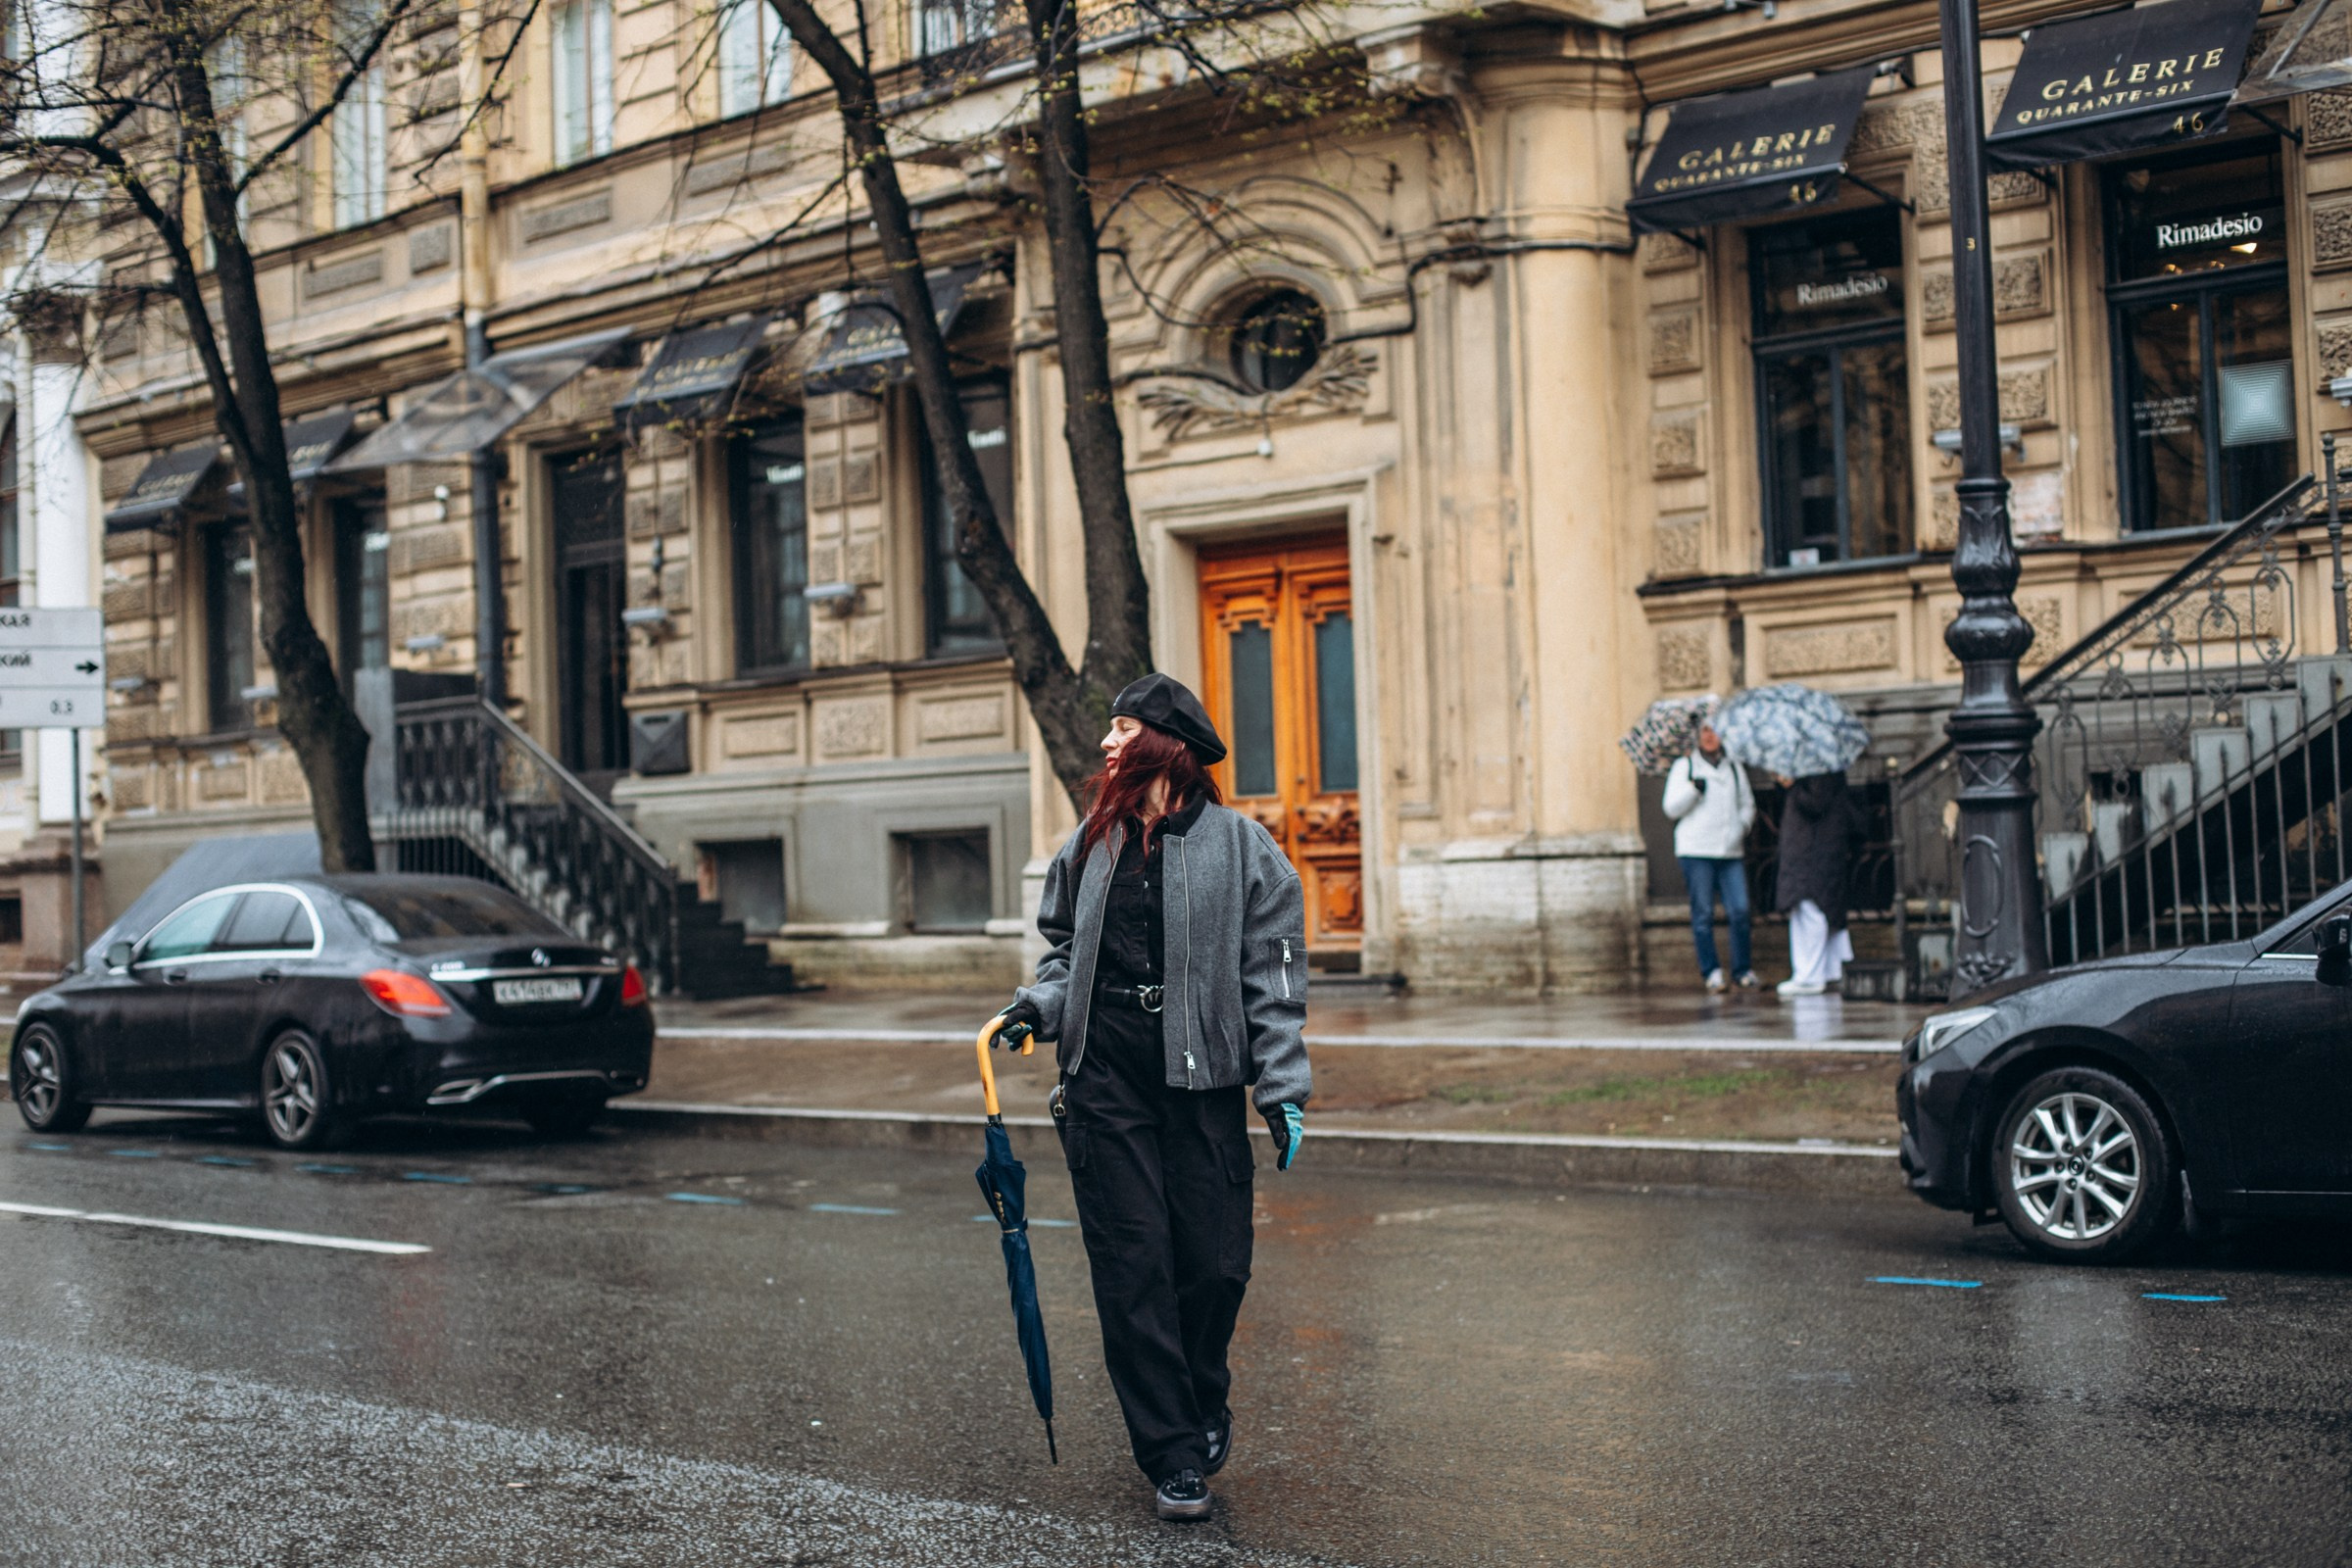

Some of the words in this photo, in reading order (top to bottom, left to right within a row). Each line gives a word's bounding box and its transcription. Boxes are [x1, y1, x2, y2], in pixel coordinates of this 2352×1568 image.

[2041, 47, 2226, 101] GALERIE
[2016, 79, 2195, 125] QUARANTE-SIX
[2172, 112, 2205, 134] 46
[1678, 123, 1836, 171] GALERIE
[1654, 154, 1807, 192] QUARANTE-SIX
[2156, 212, 2264, 249] Rimadesio
[1796, 271, 1888, 306] Rimadesio
